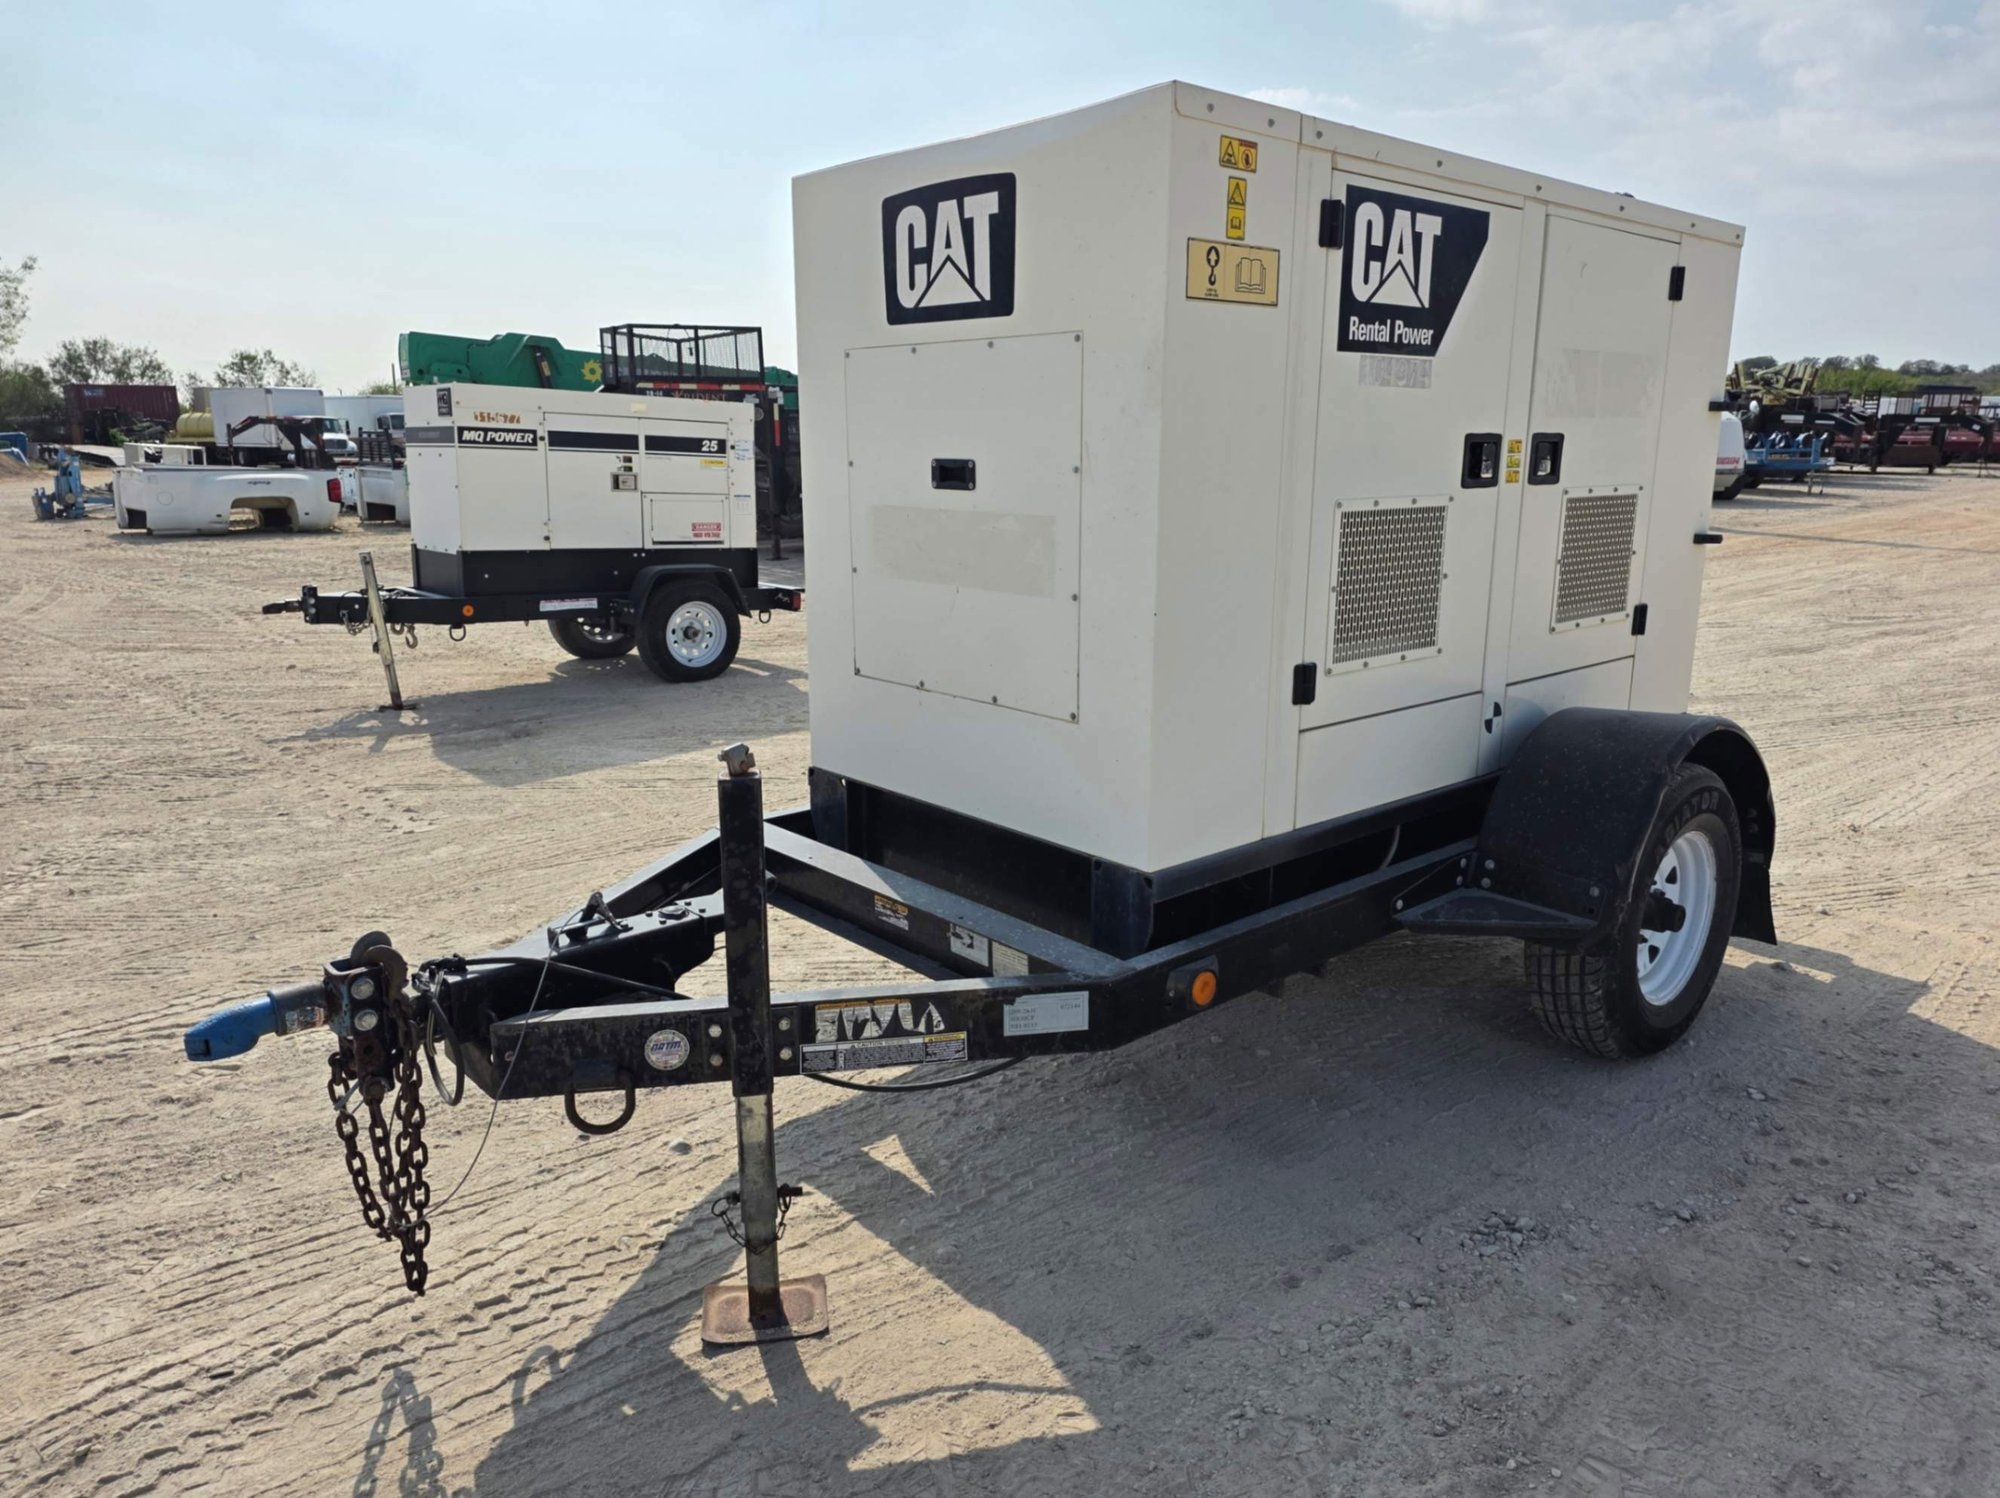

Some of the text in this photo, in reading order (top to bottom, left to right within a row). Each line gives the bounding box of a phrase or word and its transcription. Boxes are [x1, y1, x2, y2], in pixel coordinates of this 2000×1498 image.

[896, 191, 999, 308] CAT
[1350, 201, 1442, 309] CAT
[1348, 316, 1434, 345] Rental Power
[462, 430, 534, 443] MQ POWER
[701, 440, 718, 452] 25
